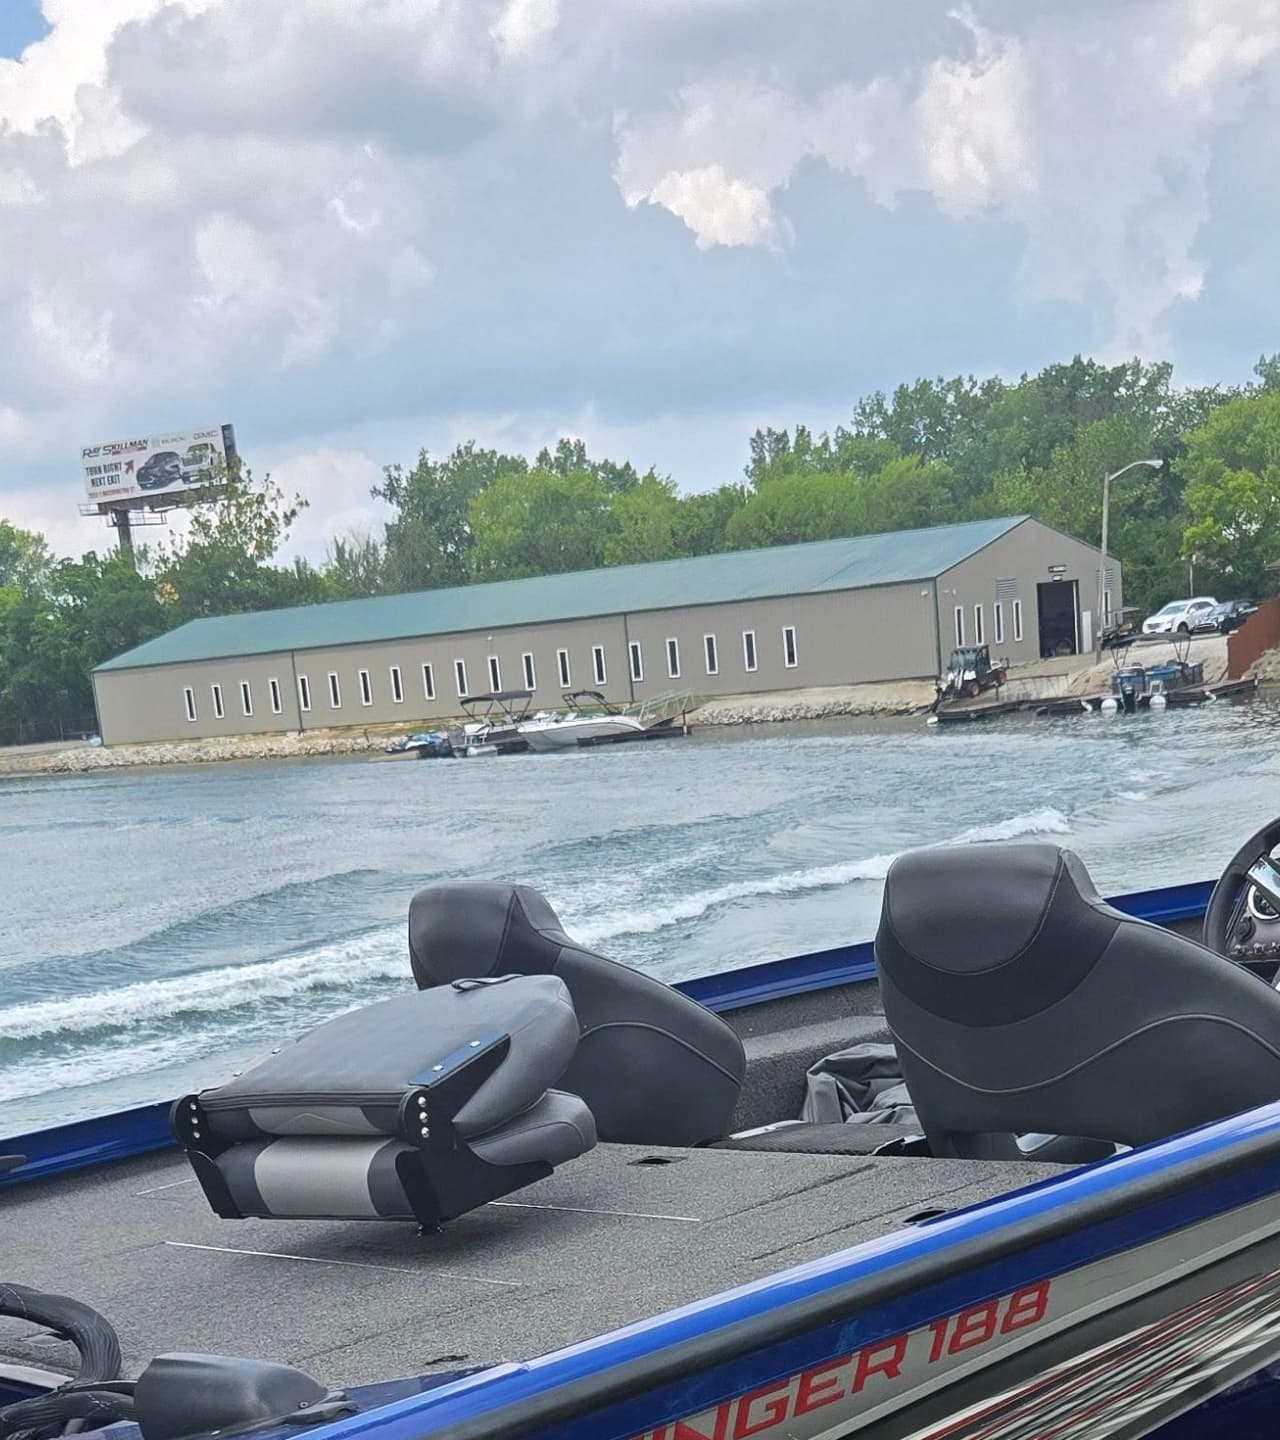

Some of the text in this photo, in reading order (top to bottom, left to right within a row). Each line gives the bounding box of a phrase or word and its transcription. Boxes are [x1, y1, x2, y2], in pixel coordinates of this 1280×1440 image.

[103, 439, 149, 456] SKILLMAN
[86, 461, 122, 476] TURN RIGHT
[91, 474, 120, 488] NEXT EXIT
[927, 1280, 1052, 1364] 188
